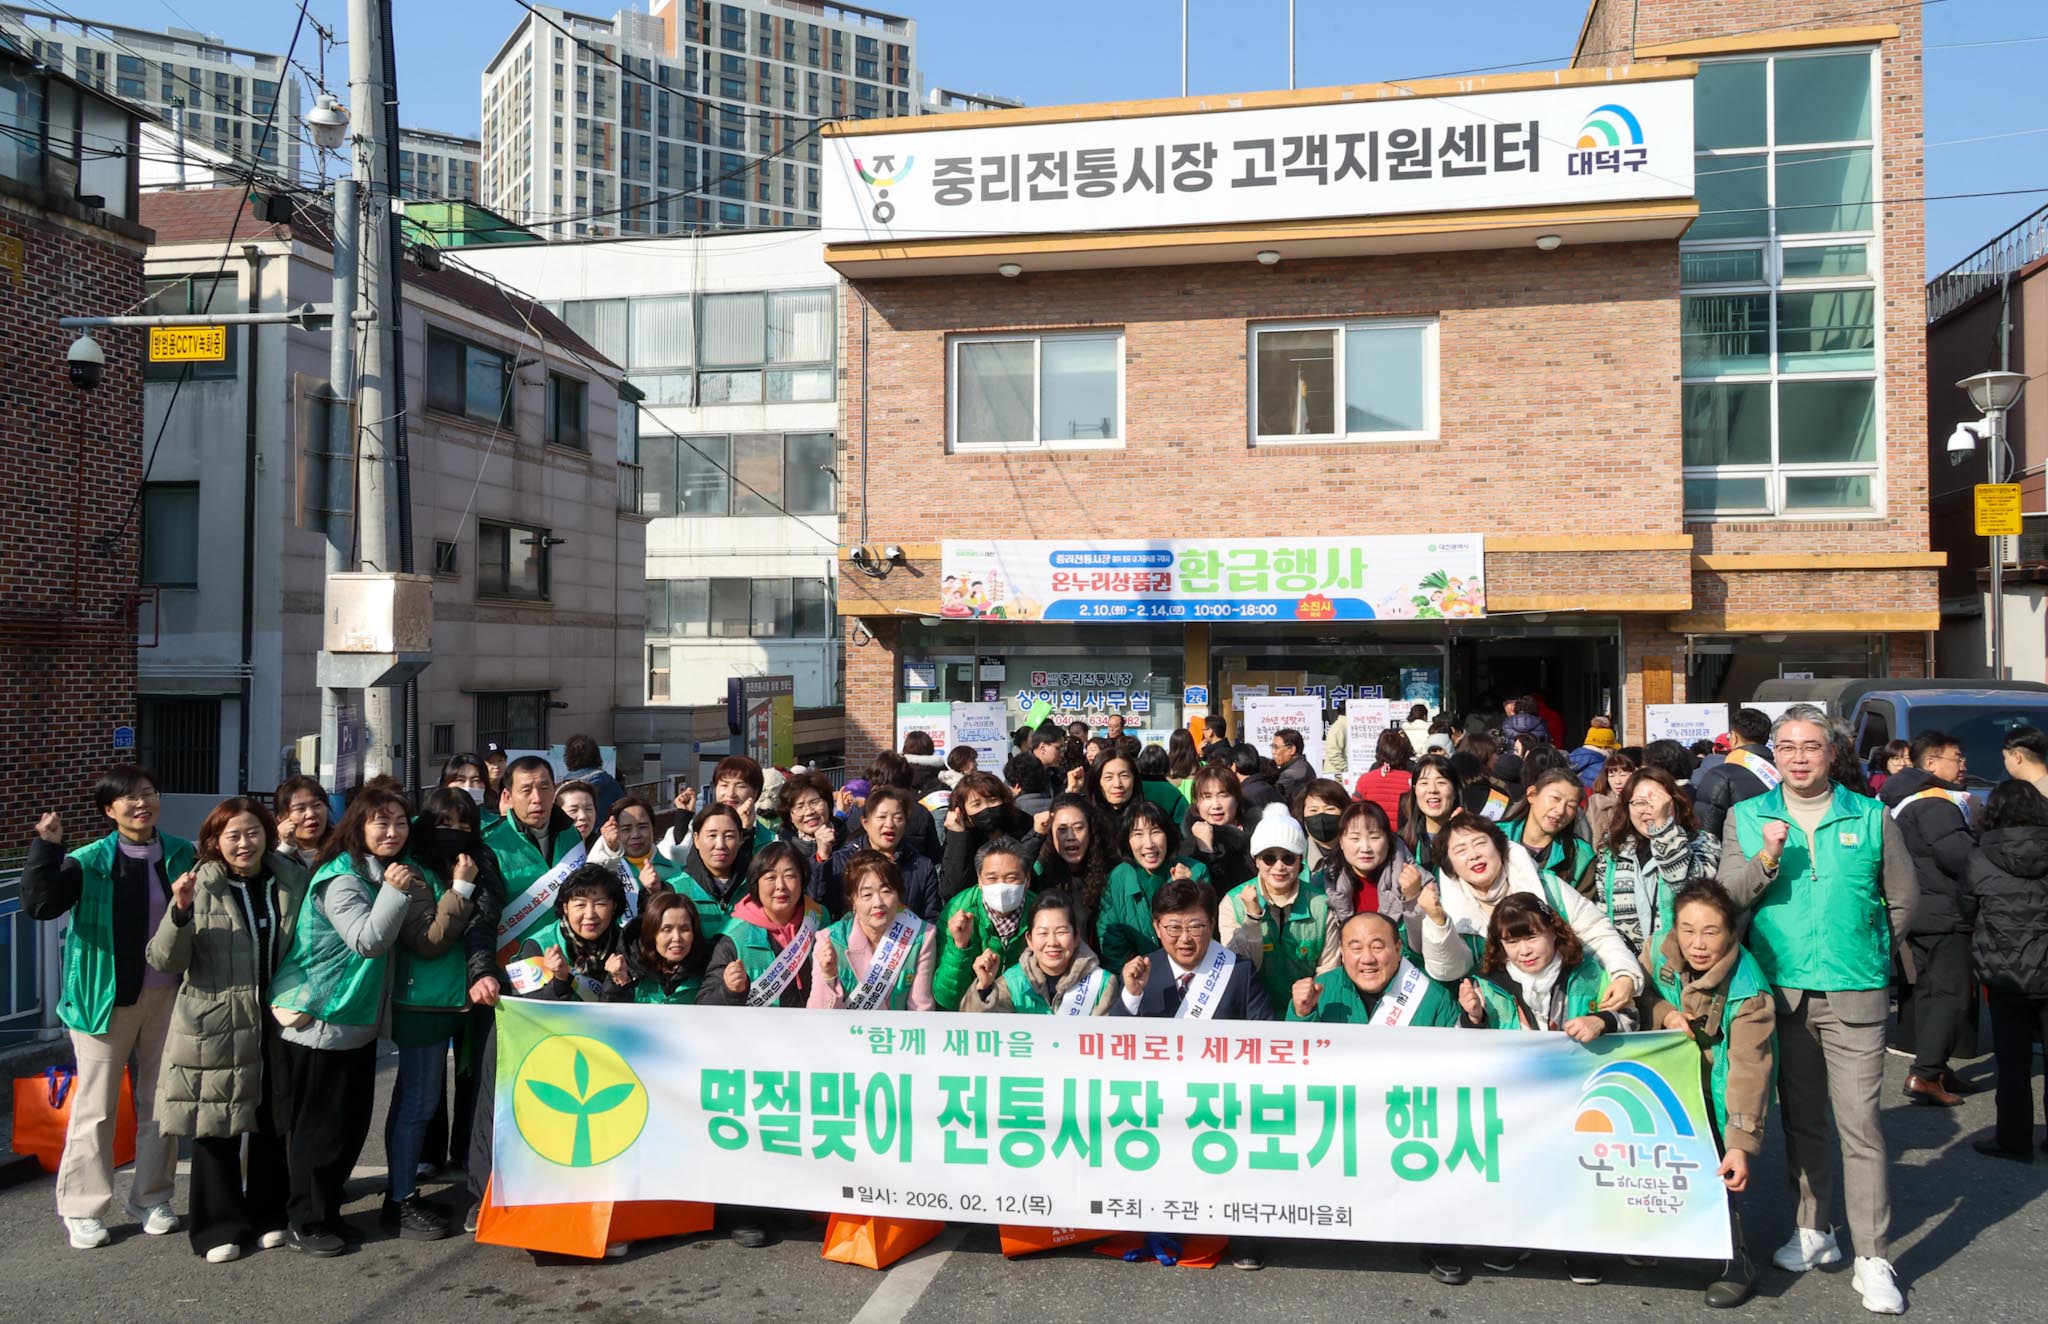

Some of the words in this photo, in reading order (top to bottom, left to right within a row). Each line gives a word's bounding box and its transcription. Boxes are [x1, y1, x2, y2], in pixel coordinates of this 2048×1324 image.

[932, 142, 1217, 206] 중리전통시장
[1231, 120, 1539, 188] 고객지원센터
[1567, 148, 1647, 176] 대덕구
[154, 333, 221, 356] 방범용CCTV녹화중
[1056, 554, 1110, 564] 중리전통시장
[1177, 547, 1368, 592] 환급행사
[1051, 572, 1171, 592] 온누리상품권
[1080, 605, 1091, 616] 2.
[1137, 605, 1148, 616] 2.
[1194, 603, 1277, 616] 10:00~18:00
[1300, 601, 1331, 611] 소진시
[1058, 672, 1133, 686] 중리전통시장
[1016, 689, 1150, 711] 상인회사무실
[1189, 695, 1203, 704] 26
[877, 920, 904, 962] 지역물가
[881, 926, 914, 982] 전통시장을
[861, 961, 882, 994] 안정에
[1206, 951, 1227, 992] 소비자의
[1199, 992, 1211, 1006] 힘
[850, 1025, 926, 1056] “함께
[943, 1028, 1036, 1058] 새마을
[1079, 1032, 1184, 1062] 미래로!
[1201, 1037, 1332, 1066] 세계로!”
[700, 1068, 912, 1163] 명절맞이
[937, 1074, 1164, 1172] 전통시장
[1185, 1081, 1358, 1177] 장보기
[1385, 1085, 1504, 1182] 행사
[906, 1191, 953, 1210] 2026.
[960, 1194, 987, 1212] 02.
[996, 1195, 1052, 1216] 12.(목)
[1162, 1199, 1200, 1222] 주관
[1224, 1201, 1352, 1228] 대덕구새마을회
[1627, 1194, 1685, 1214] 대한민국
